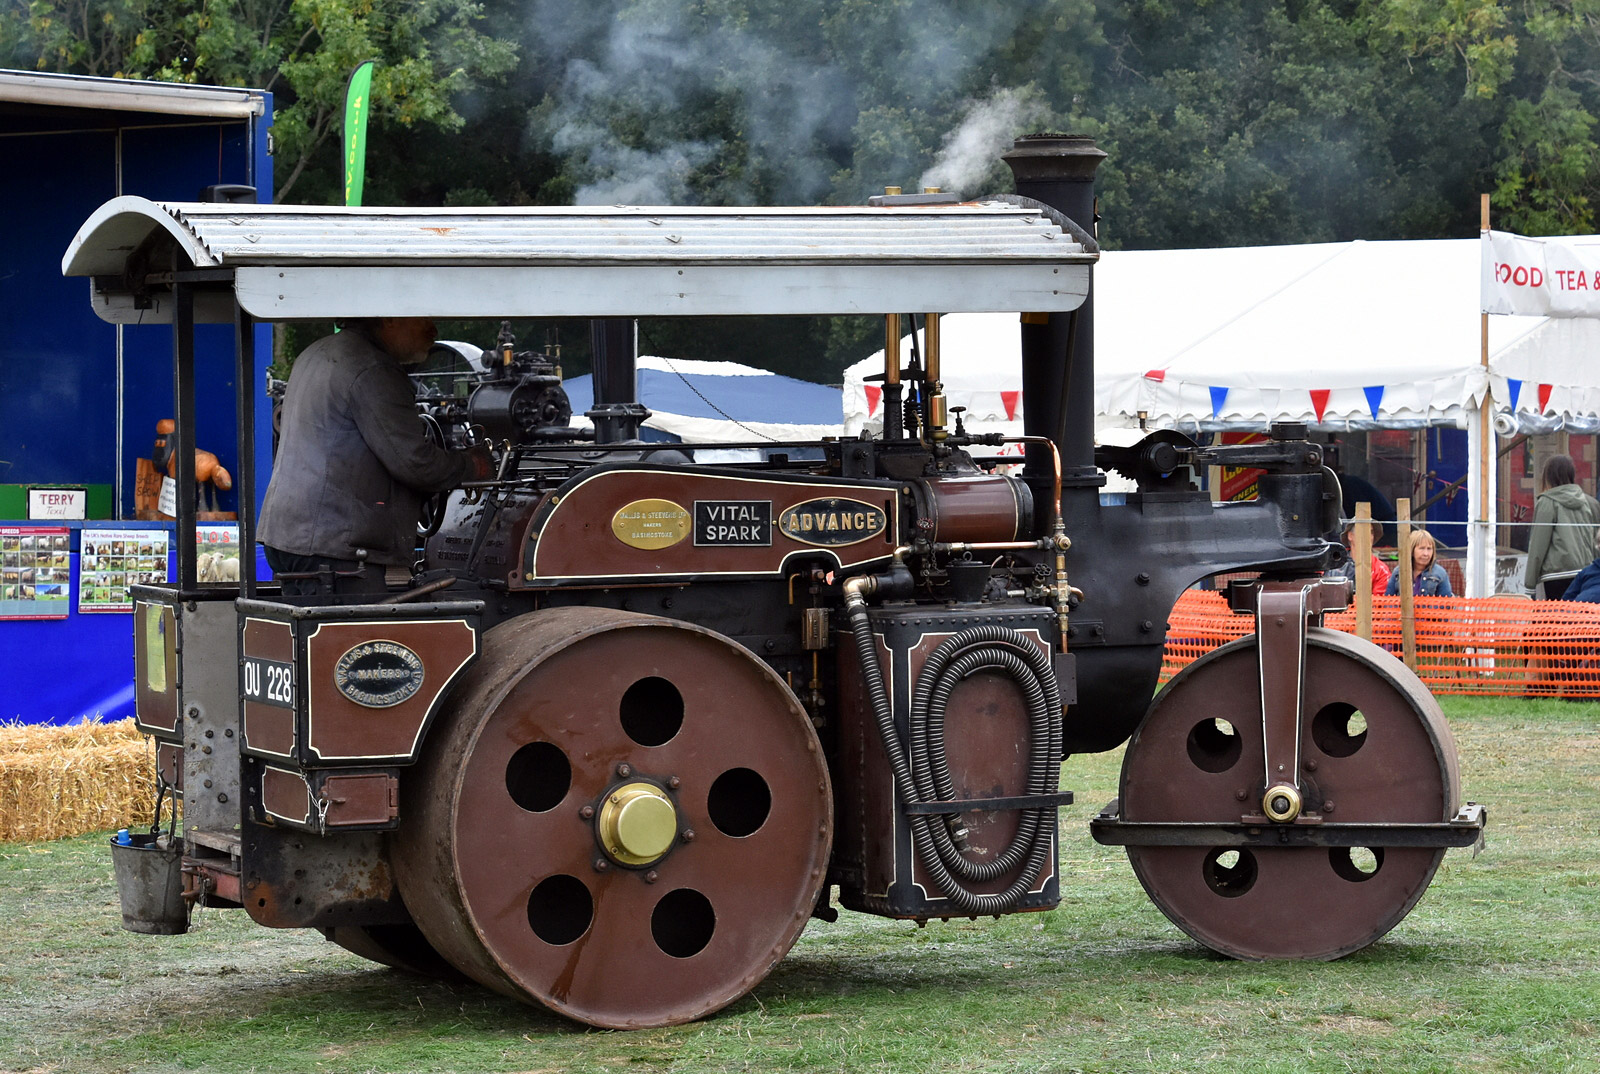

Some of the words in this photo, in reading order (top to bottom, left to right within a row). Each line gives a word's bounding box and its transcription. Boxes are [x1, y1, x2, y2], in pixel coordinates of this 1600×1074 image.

[1494, 262, 1543, 288] FOOD
[1555, 270, 1588, 290] TEA
[40, 493, 74, 505] TERRY
[706, 505, 760, 521] VITAL
[788, 512, 877, 532] ADVANCE
[706, 525, 761, 541] SPARK
[245, 661, 260, 697] OU
[267, 665, 292, 703] 228
[357, 668, 402, 680] MAKERS
